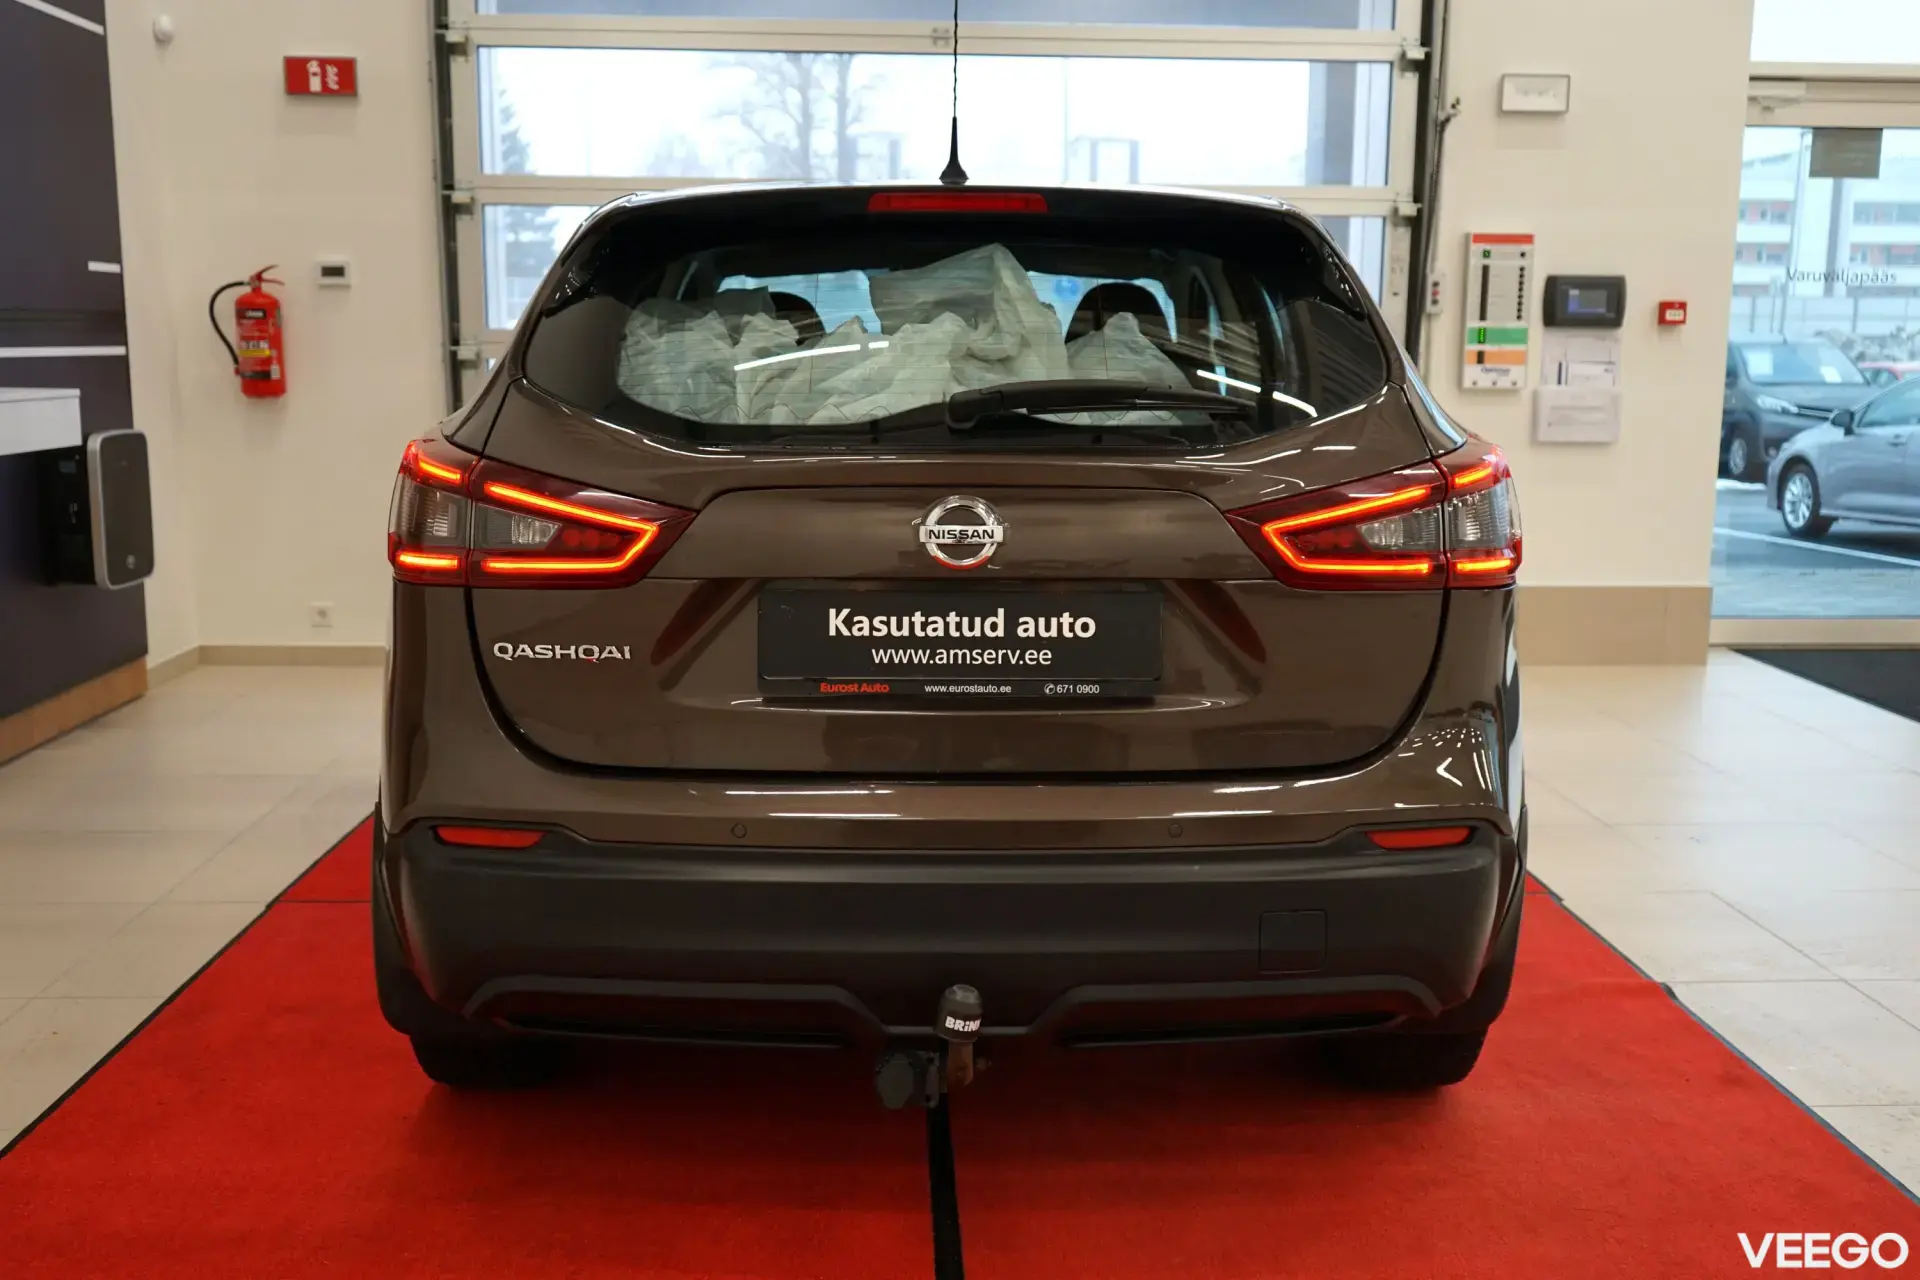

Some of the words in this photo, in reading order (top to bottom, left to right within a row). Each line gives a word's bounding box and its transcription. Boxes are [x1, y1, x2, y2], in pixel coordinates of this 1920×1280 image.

[928, 529, 995, 540] NISSAN
[828, 607, 1005, 638] Kasutatud
[1016, 611, 1097, 638] auto
[493, 642, 631, 663] QASHQAI
[871, 648, 1052, 665] www.amserv.ee
[820, 682, 859, 693] Eurost
[860, 682, 890, 693] Auto
[924, 684, 1012, 693] www.eurostauto.ee
[1056, 684, 1073, 693] 671
[1077, 684, 1100, 694] 0900
